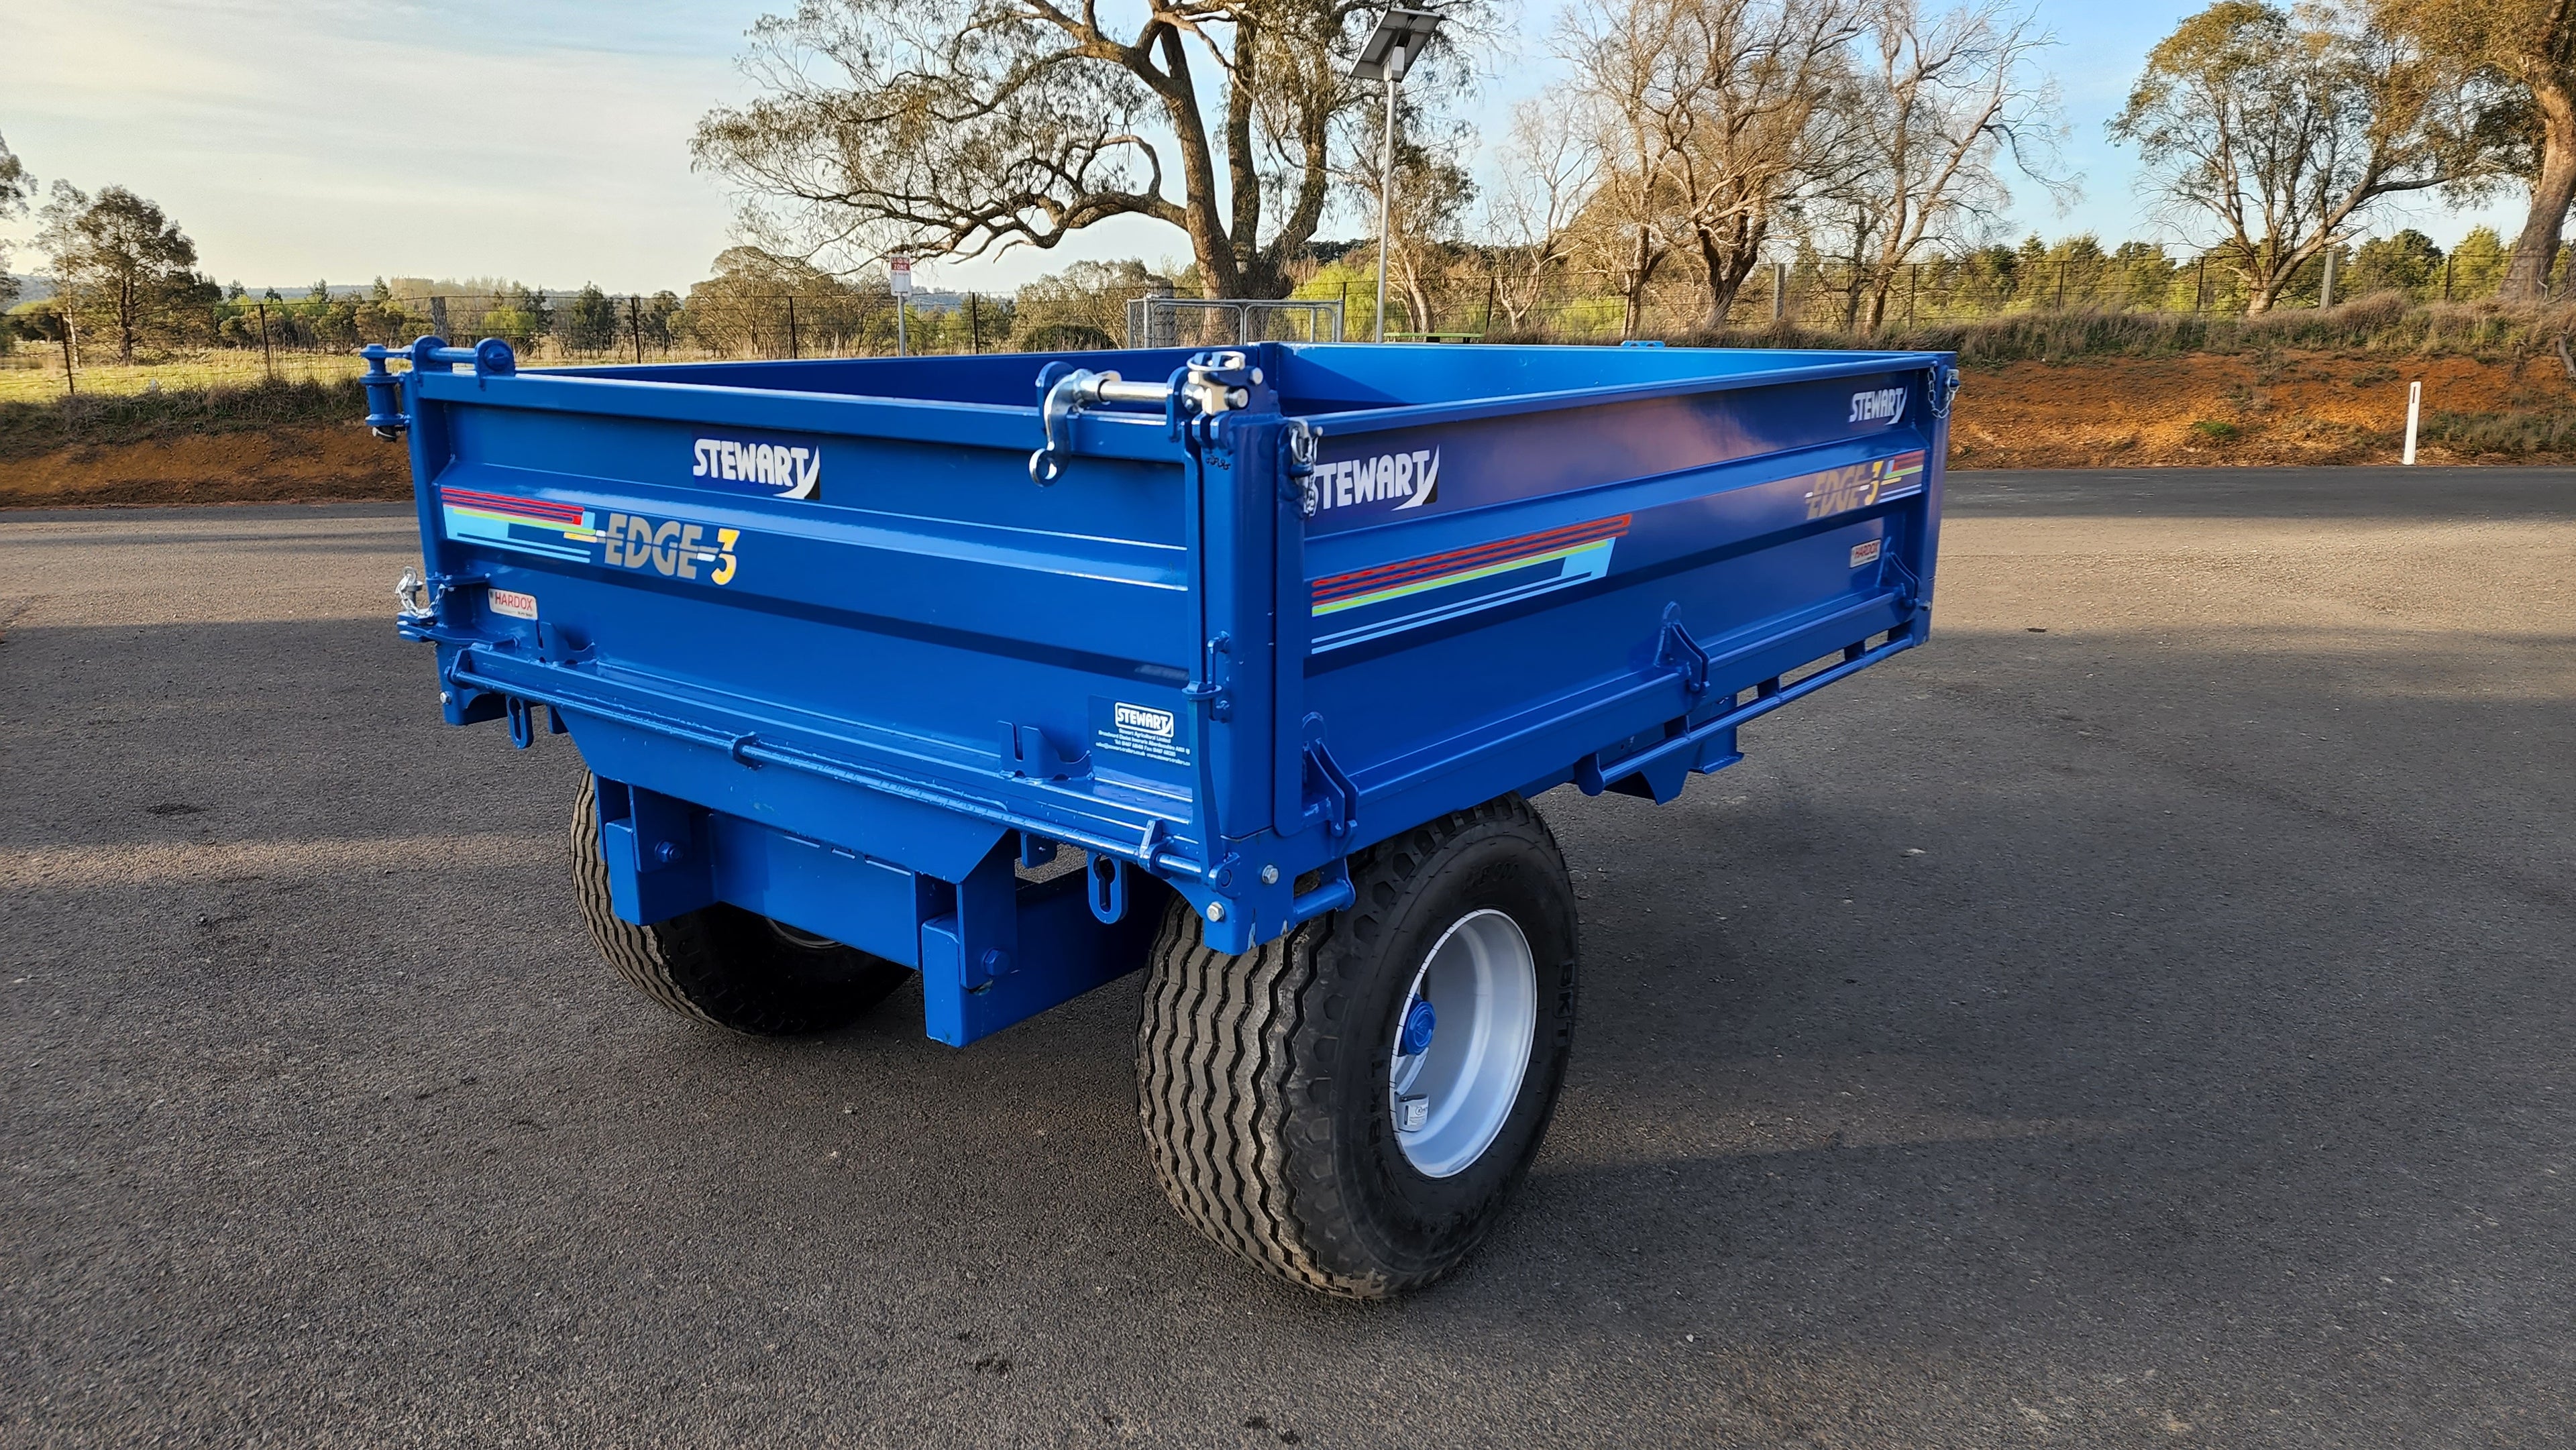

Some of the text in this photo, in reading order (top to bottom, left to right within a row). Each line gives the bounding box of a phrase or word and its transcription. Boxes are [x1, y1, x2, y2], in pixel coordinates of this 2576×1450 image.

[1849, 386, 1907, 425] STEWART
[693, 438, 820, 499] STEWART
[604, 512, 740, 585] EDGE-3
[495, 592, 533, 611] HARDOX
[1117, 708, 1173, 736] STEWART
